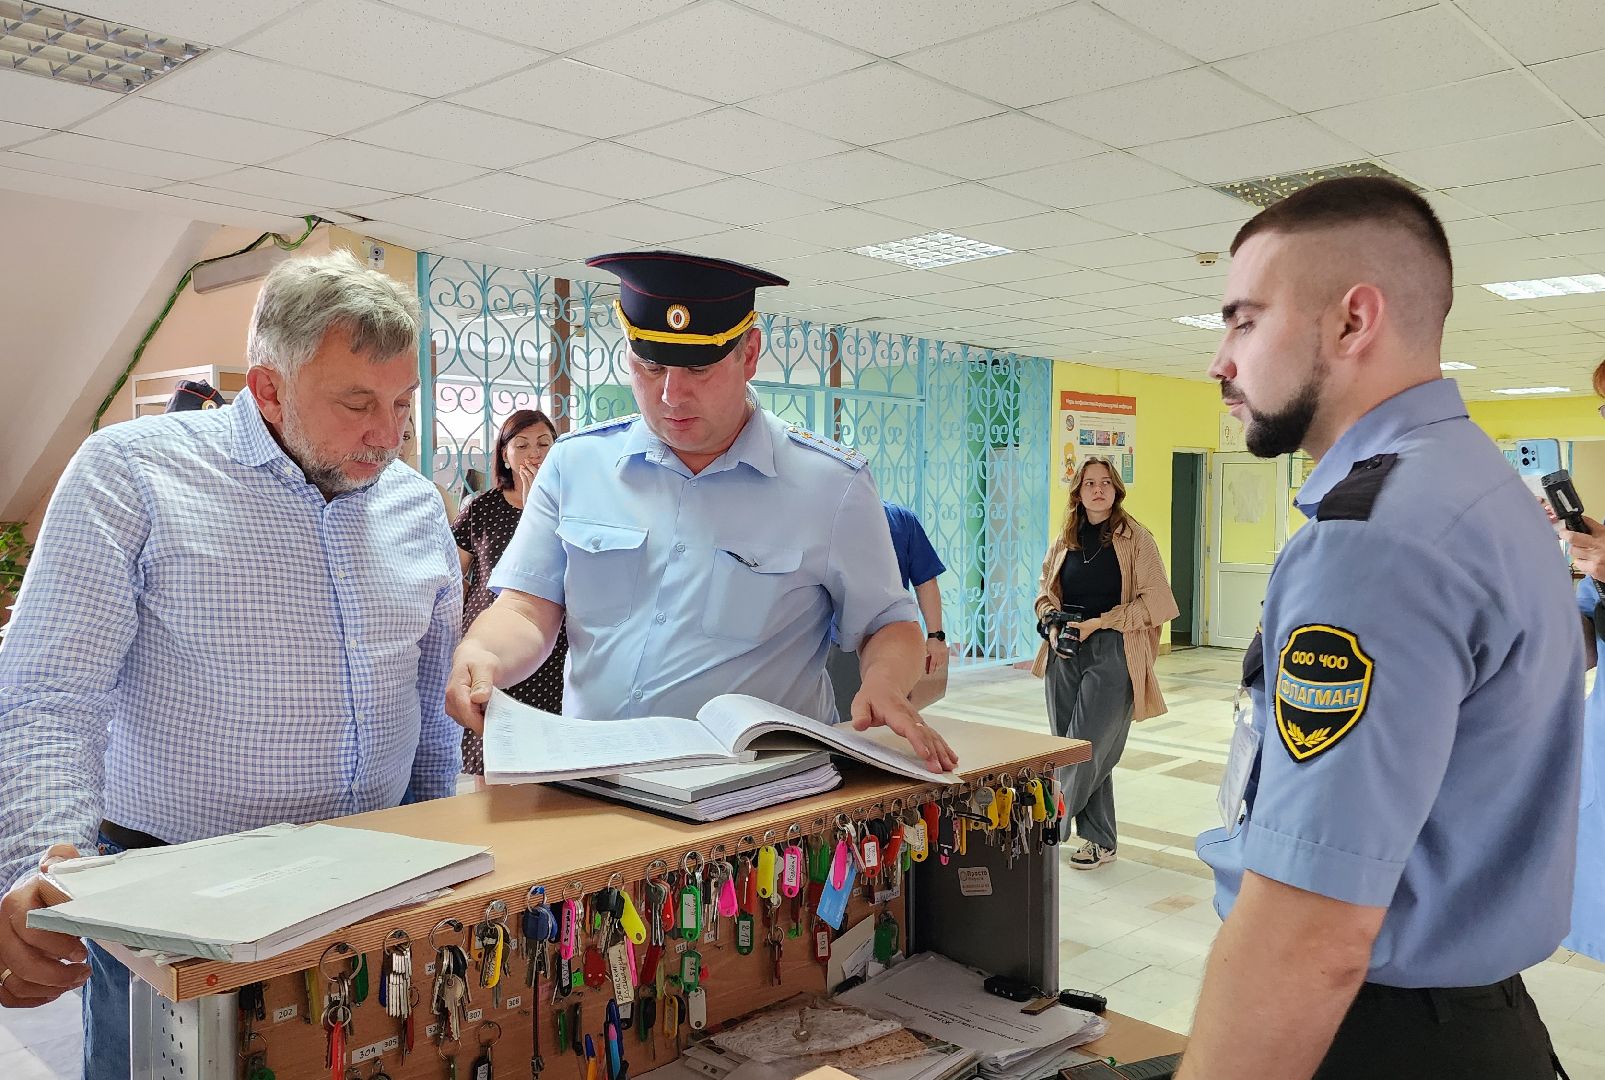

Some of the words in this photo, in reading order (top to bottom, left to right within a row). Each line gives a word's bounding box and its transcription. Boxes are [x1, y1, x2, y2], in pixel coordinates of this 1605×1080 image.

[1291, 650, 1316, 666] ООО
[1280, 679, 1360, 706] ФЛАГМАН
[278, 1008, 293, 1019] 202
[359, 1046, 376, 1060] 304
